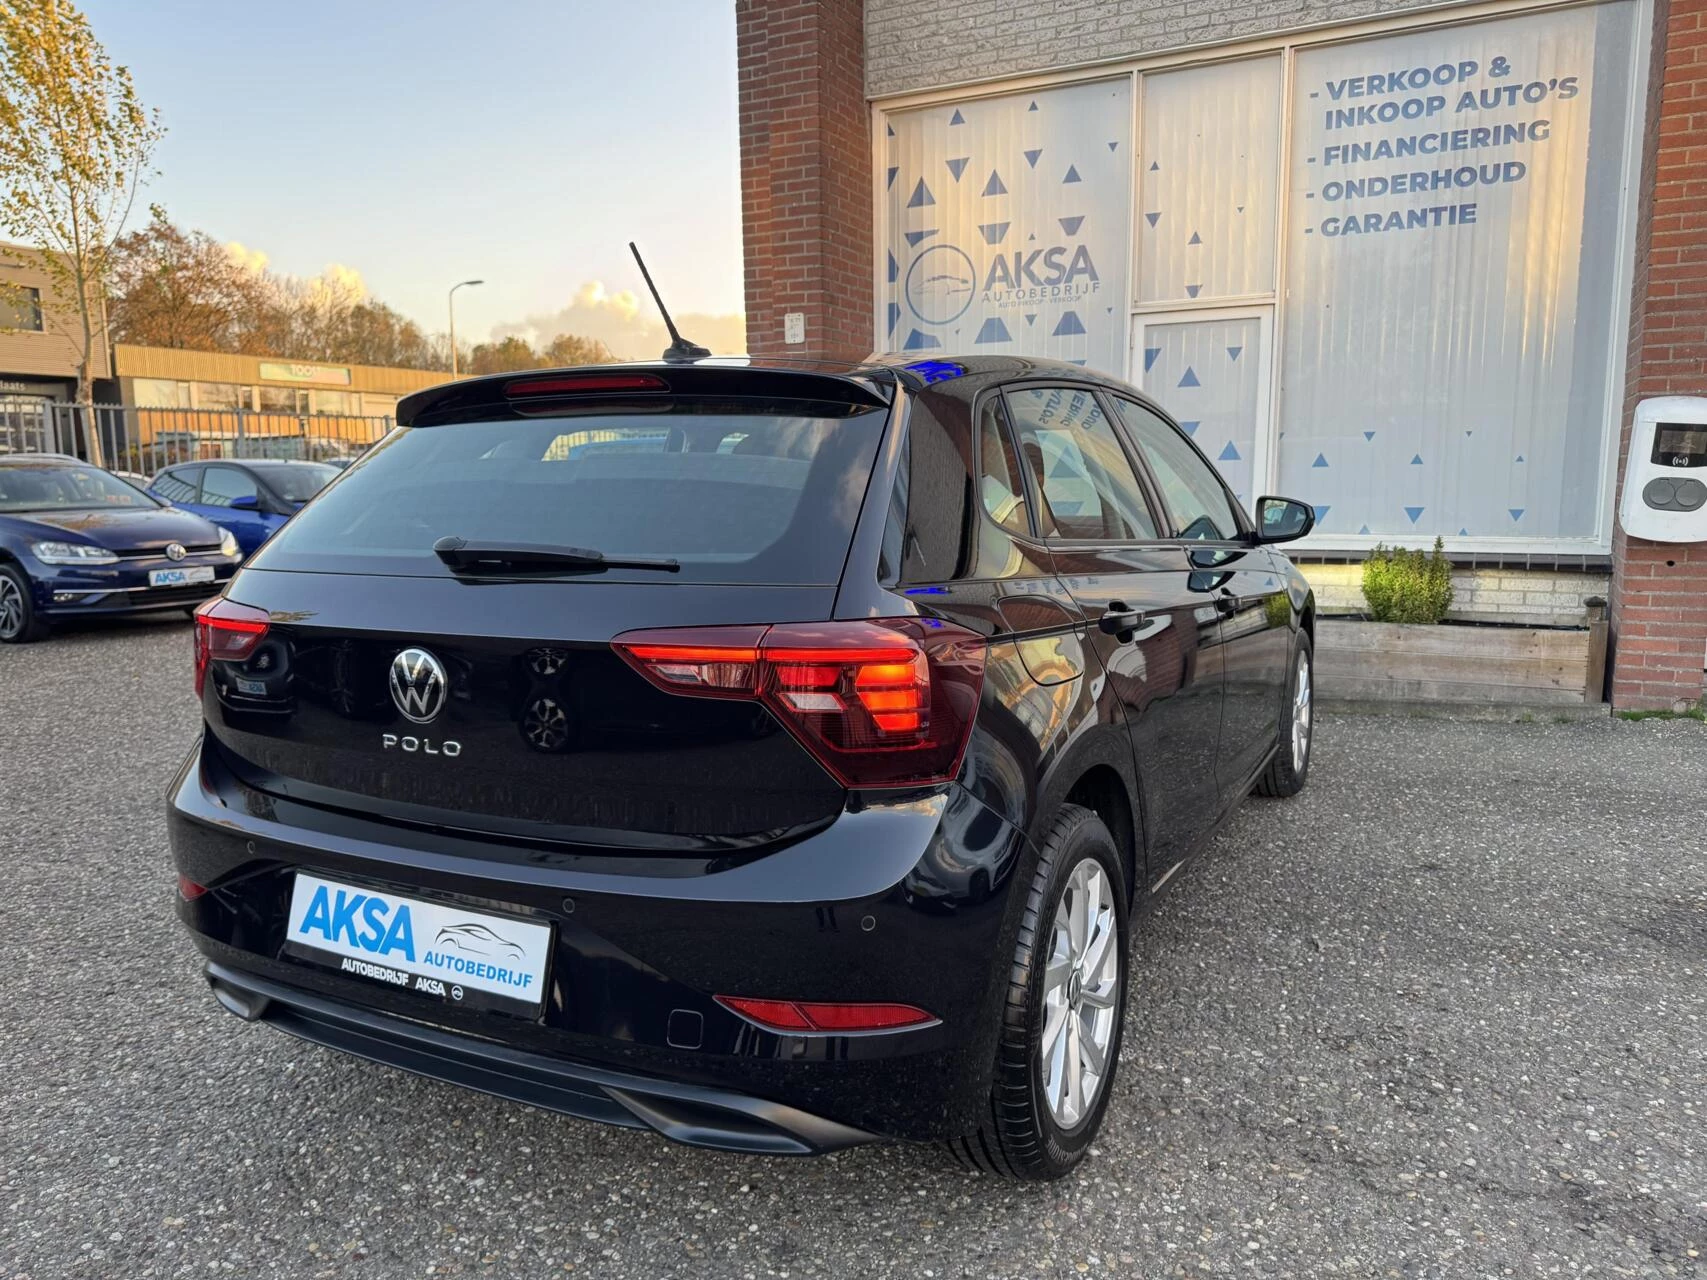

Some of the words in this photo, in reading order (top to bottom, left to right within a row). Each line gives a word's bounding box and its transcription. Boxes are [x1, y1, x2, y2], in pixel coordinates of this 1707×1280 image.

[1326, 61, 1479, 100] VERKOOP
[1488, 56, 1511, 78] &
[1325, 95, 1446, 130] INKOOP
[1455, 77, 1578, 113] AUTO'S
[1324, 119, 1550, 166] FINANCIERING
[1322, 161, 1526, 201] ONDERHOUD
[1321, 203, 1477, 237] GARANTIE
[983, 245, 1099, 291] AKSA
[982, 282, 1101, 303] AUTOBEDRIJF
[155, 571, 186, 584] AKSA
[383, 734, 461, 756] POLO
[300, 885, 416, 962] AKSA
[341, 958, 409, 986] AUTOBEDRIJF
[415, 977, 446, 997] AKSA
[424, 951, 533, 988] AUTOBEDRIJF
